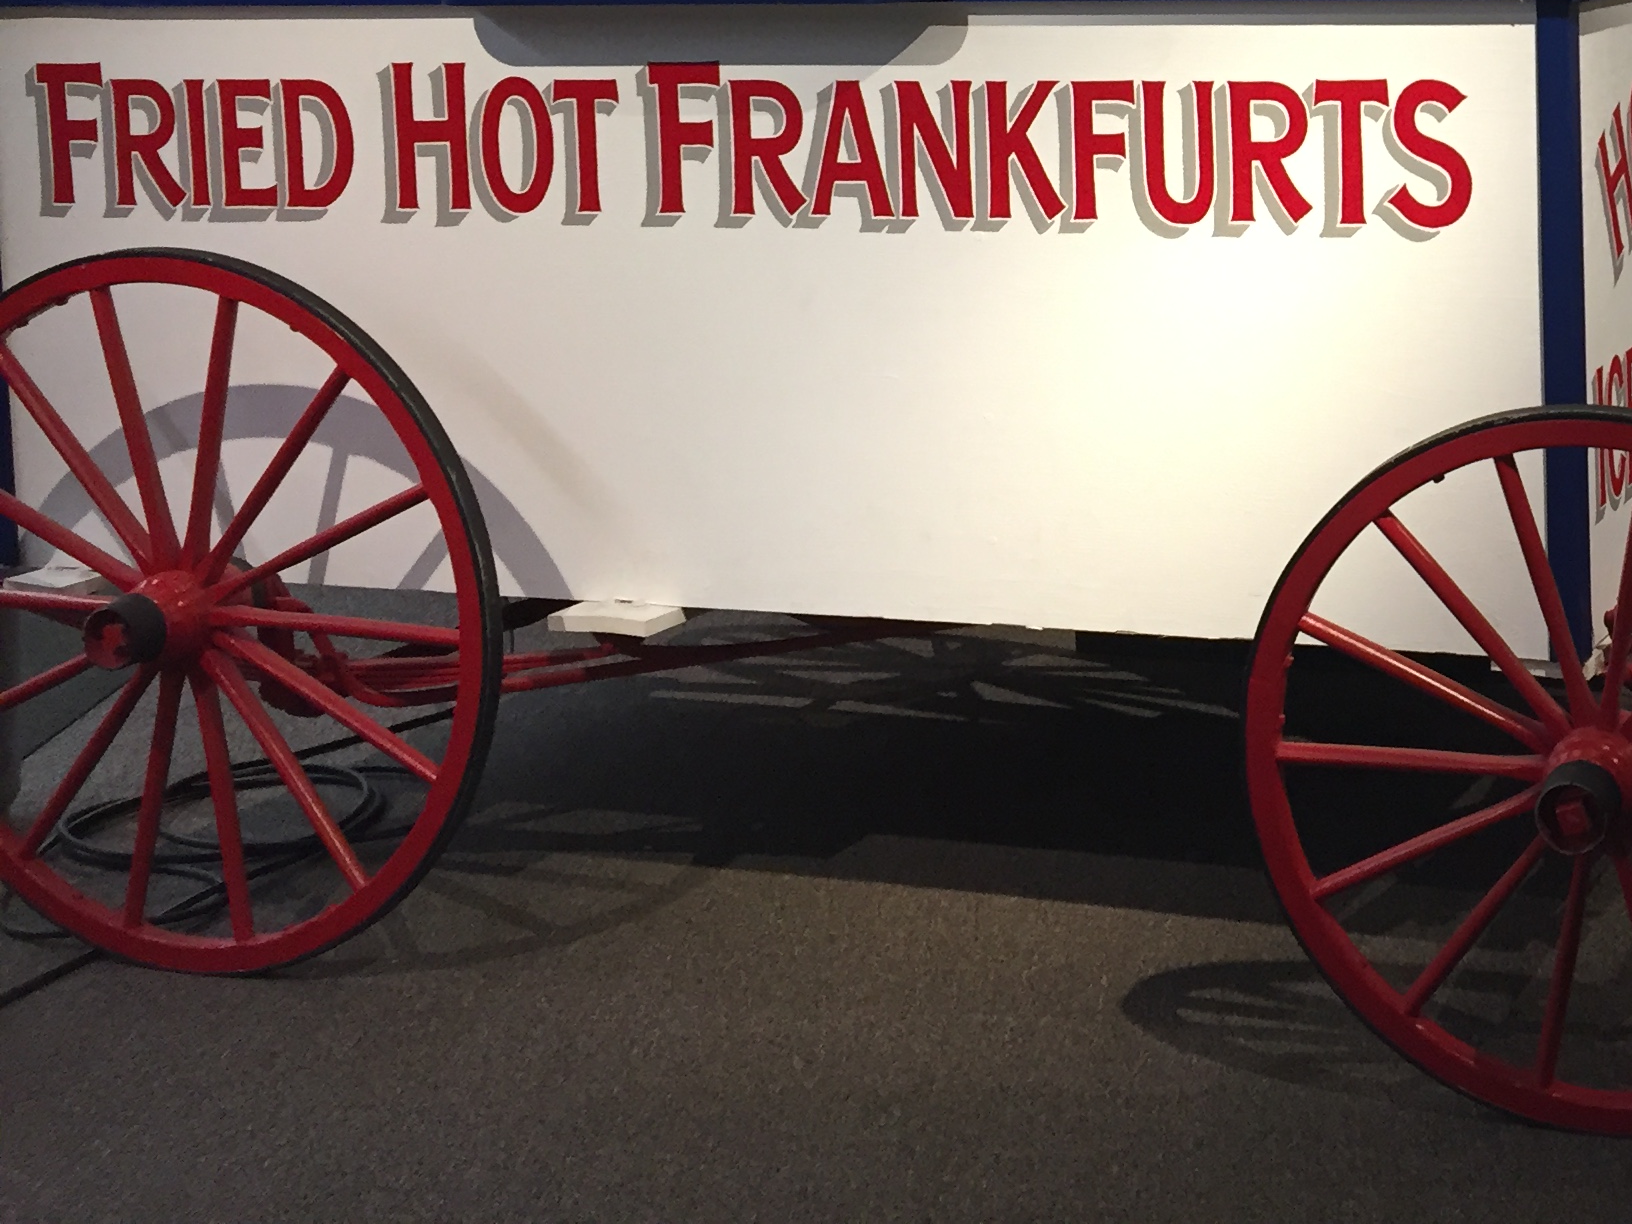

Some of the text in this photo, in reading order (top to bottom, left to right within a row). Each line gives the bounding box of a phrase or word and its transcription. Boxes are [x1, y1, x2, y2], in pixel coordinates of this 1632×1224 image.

[30, 60, 1474, 236] FRIED HOT FRANKFURTS
